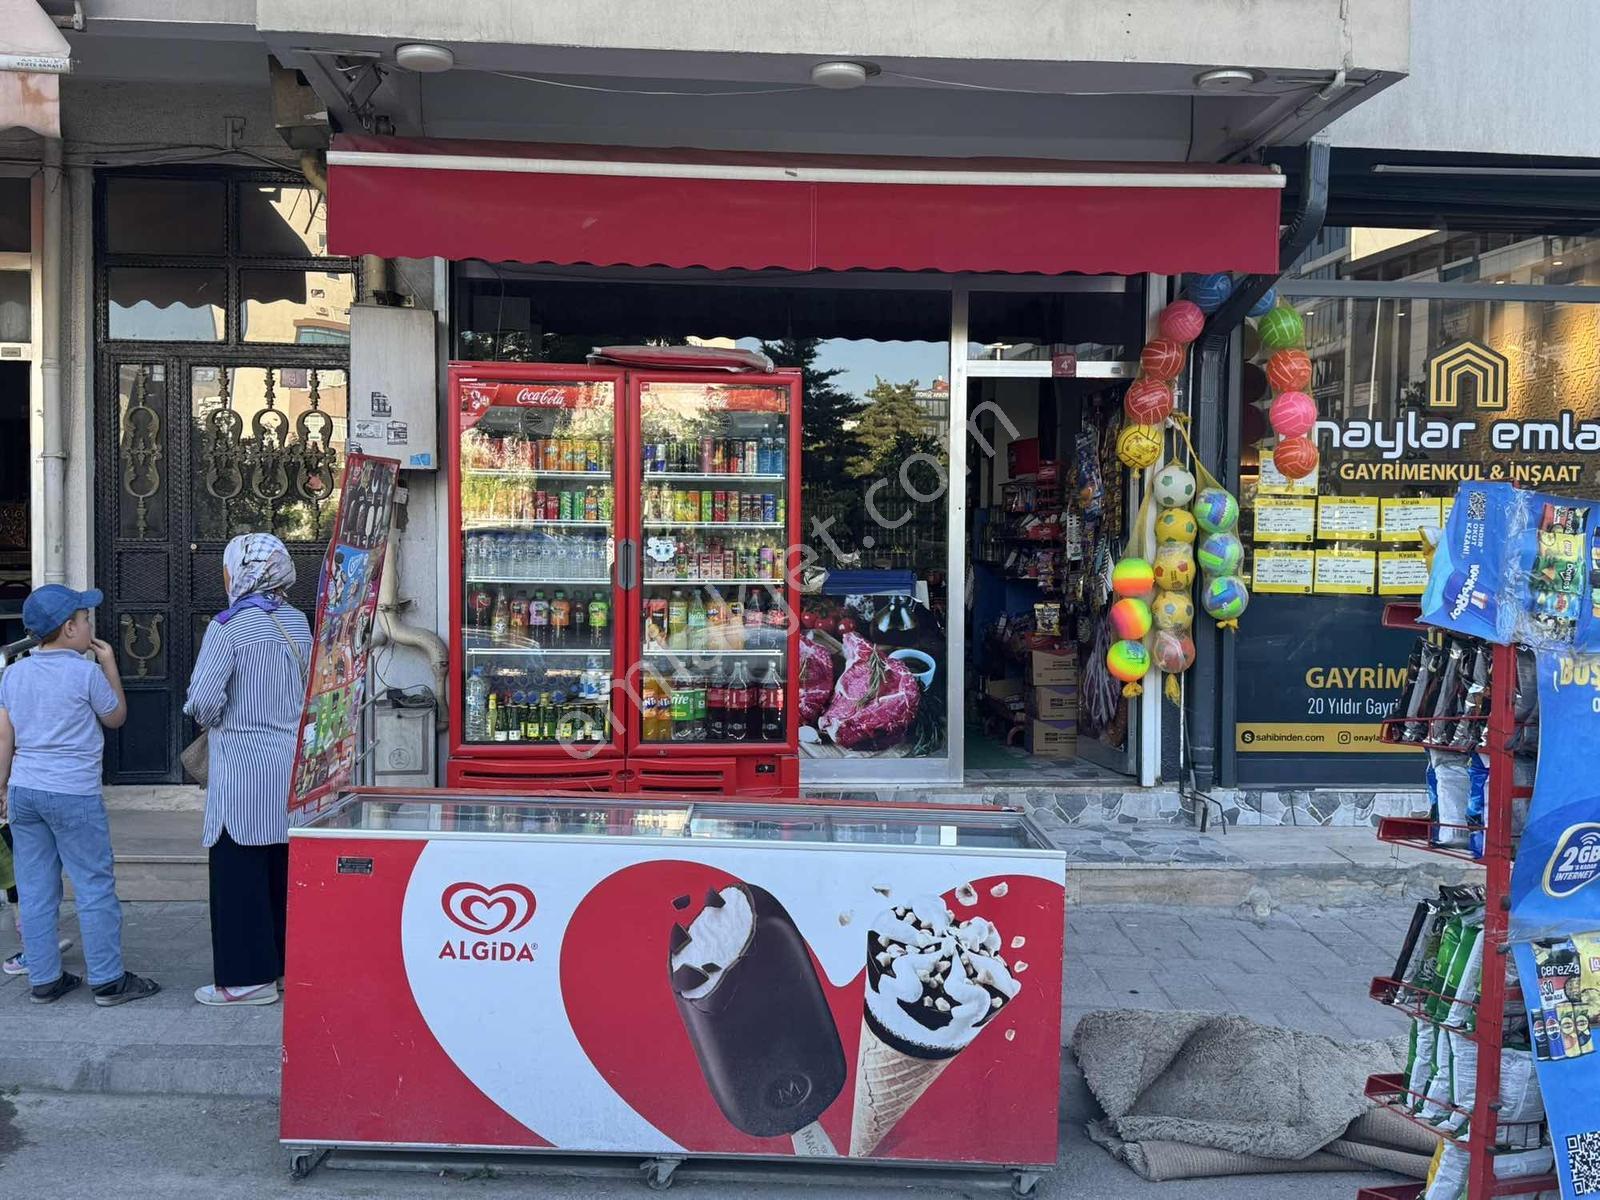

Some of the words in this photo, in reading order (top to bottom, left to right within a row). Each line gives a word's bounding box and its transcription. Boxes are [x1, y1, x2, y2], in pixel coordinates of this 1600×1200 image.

[516, 388, 565, 405] Coca-Cola
[1279, 411, 1476, 459] naylar
[1340, 460, 1484, 481] GAYRİMENKUL
[1489, 465, 1505, 481] &
[1510, 461, 1581, 486] İNŞAAT
[1308, 698, 1324, 715] 20
[1328, 697, 1362, 715] Yıldır
[1256, 733, 1324, 742] sahibinden.com
